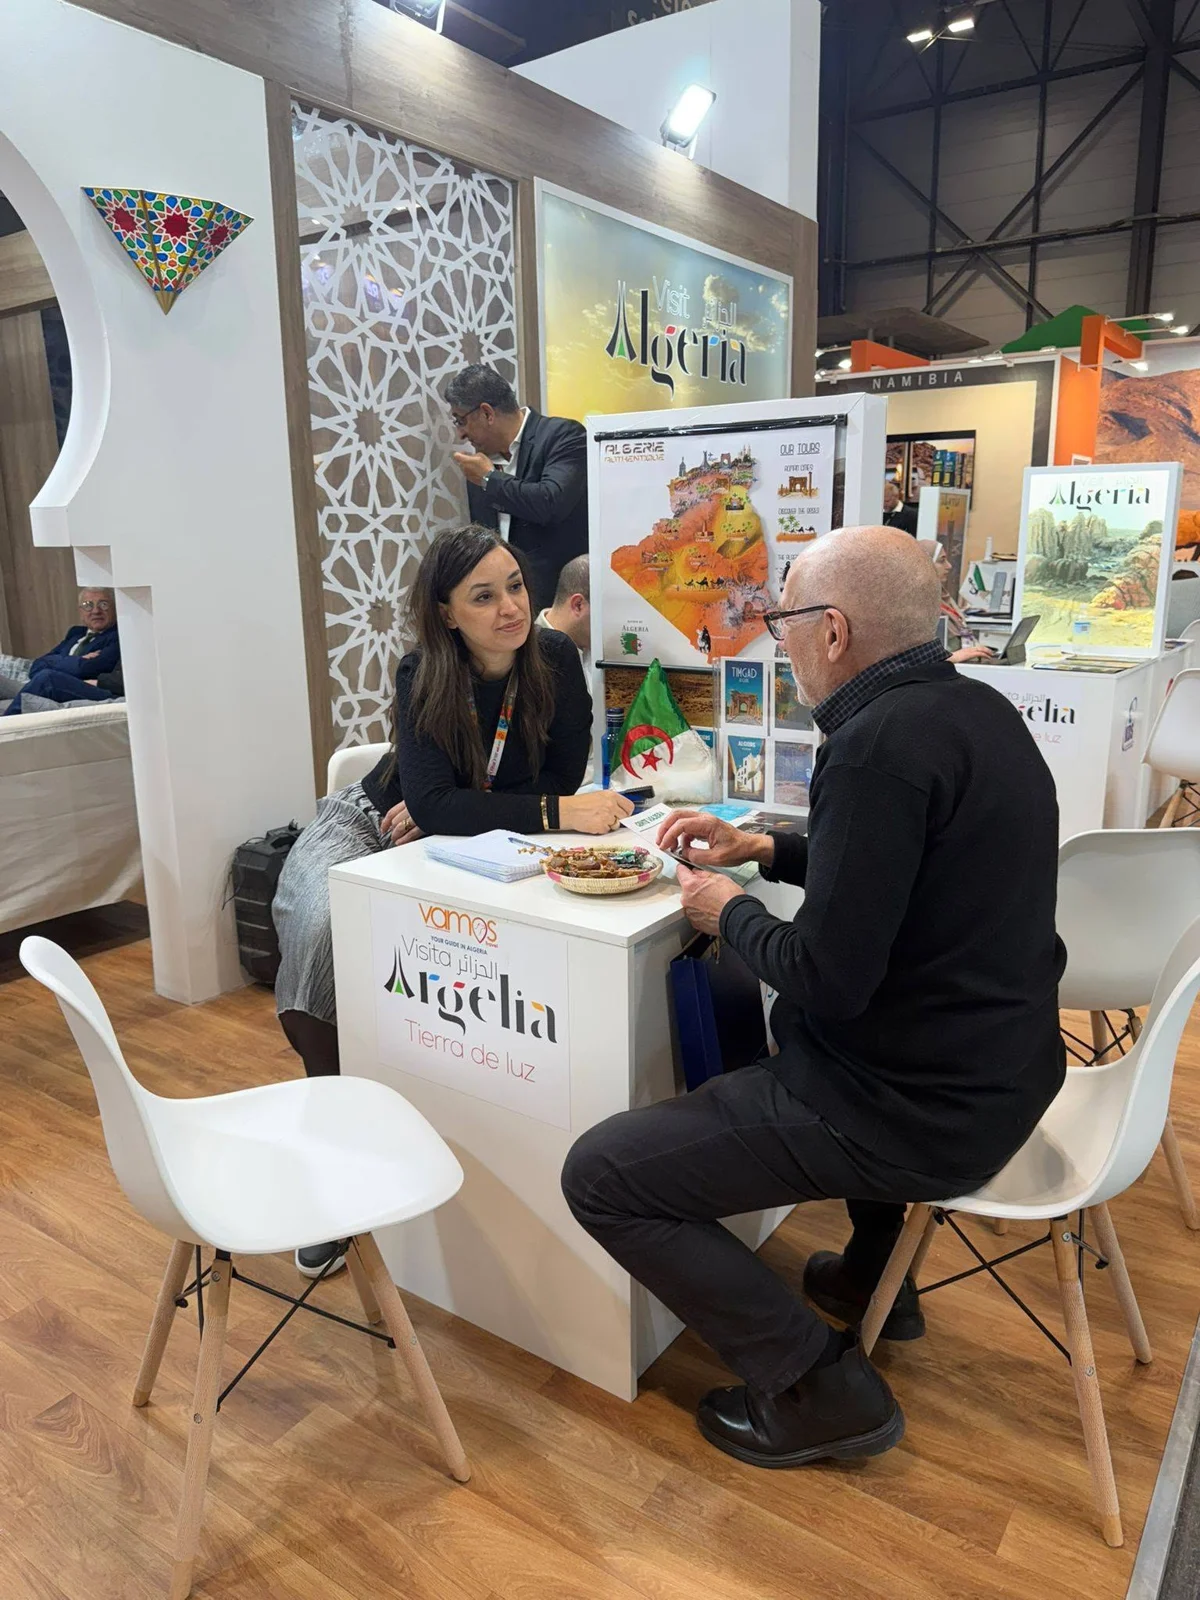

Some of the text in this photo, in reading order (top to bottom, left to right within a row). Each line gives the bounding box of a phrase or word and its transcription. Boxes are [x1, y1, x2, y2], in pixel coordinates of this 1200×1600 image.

[652, 275, 691, 319] Visit
[605, 280, 747, 401] Algeria
[872, 371, 963, 390] NAMIBIA
[605, 441, 665, 455] ALGERIE
[780, 442, 821, 456] OUR TOURS
[1049, 480, 1150, 512] Algeria
[732, 667, 757, 678] TIMGAD
[401, 934, 451, 967] Visita
[431, 935, 444, 945] YOUR
[445, 939, 460, 948] GUIDE
[467, 945, 488, 955] ALGERIA
[384, 945, 557, 1044] Argelia
[404, 1018, 536, 1083] Tierra de luz
